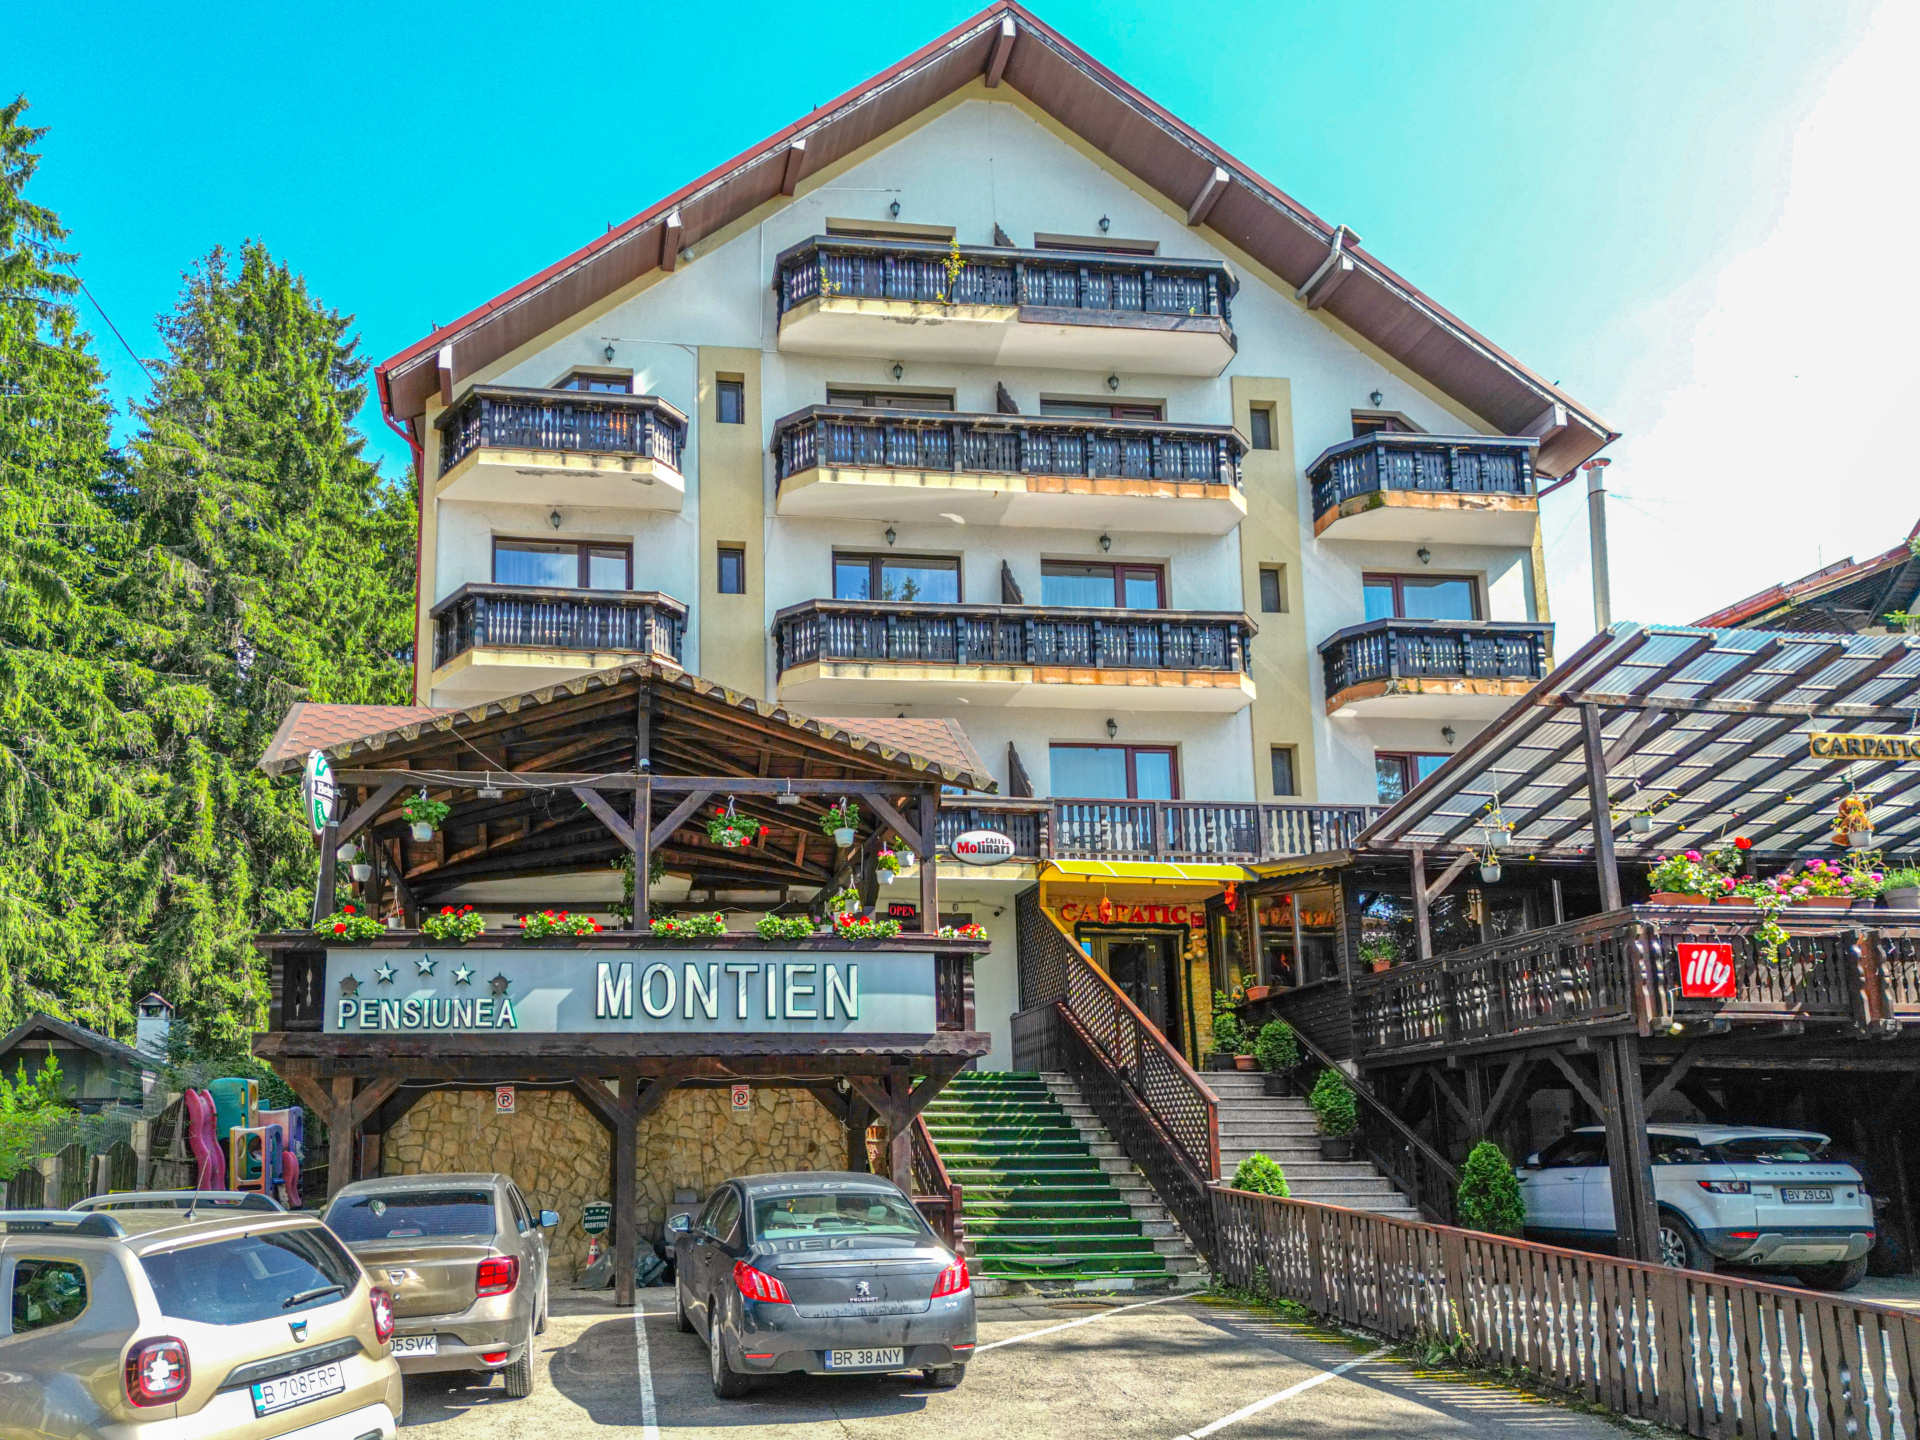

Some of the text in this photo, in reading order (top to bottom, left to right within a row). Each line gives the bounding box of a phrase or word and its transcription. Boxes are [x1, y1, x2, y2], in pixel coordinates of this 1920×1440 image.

[956, 841, 1011, 855] Molinari
[888, 905, 915, 917] OPEN
[1686, 949, 1731, 993] illy
[337, 961, 859, 1030] PENSIUNEA MONTIEN
[1787, 1190, 1800, 1200] BV
[584, 1221, 608, 1229] MONTIEN
[255, 1345, 347, 1375] DUSTER
[833, 1352, 853, 1365] BR
[262, 1385, 275, 1404] B
